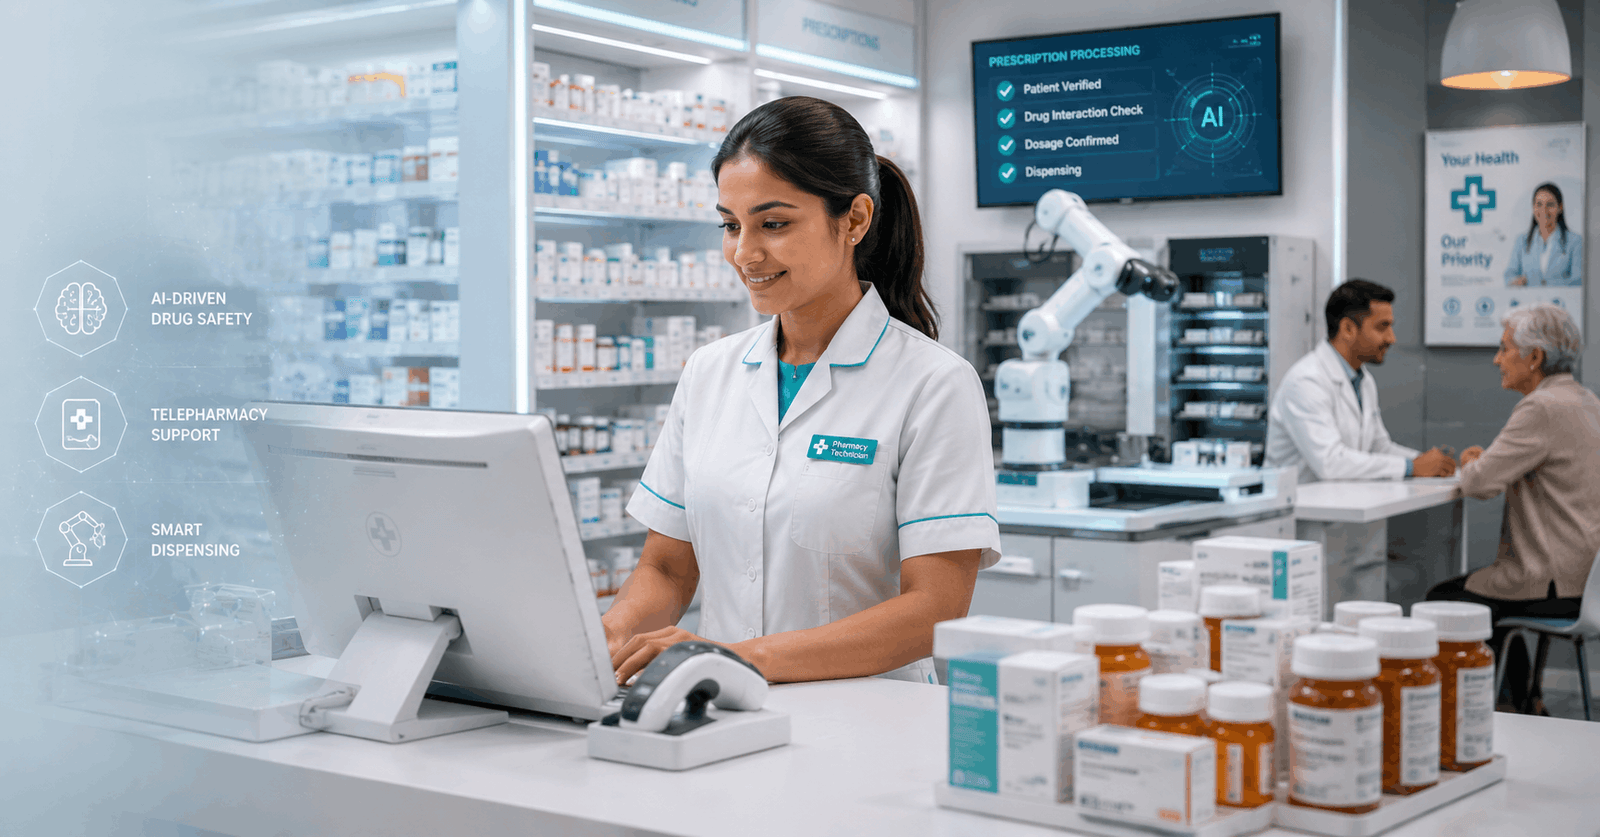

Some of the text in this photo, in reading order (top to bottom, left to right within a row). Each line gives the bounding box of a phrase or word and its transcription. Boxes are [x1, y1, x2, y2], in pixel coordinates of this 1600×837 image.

[988, 45, 1141, 67] PRESCRIPTION PROCESSING
[1023, 79, 1102, 95] Patient Verified
[1024, 104, 1144, 124] Drug Interaction Check
[1200, 106, 1224, 128] AI
[1024, 134, 1120, 151] Dosage Confirmed
[1441, 151, 1519, 167] Your Health
[1025, 164, 1082, 179] Dispensing
[1441, 234, 1467, 248] Our
[1441, 252, 1492, 270] Priority
[832, 440, 868, 452] Pharmacy
